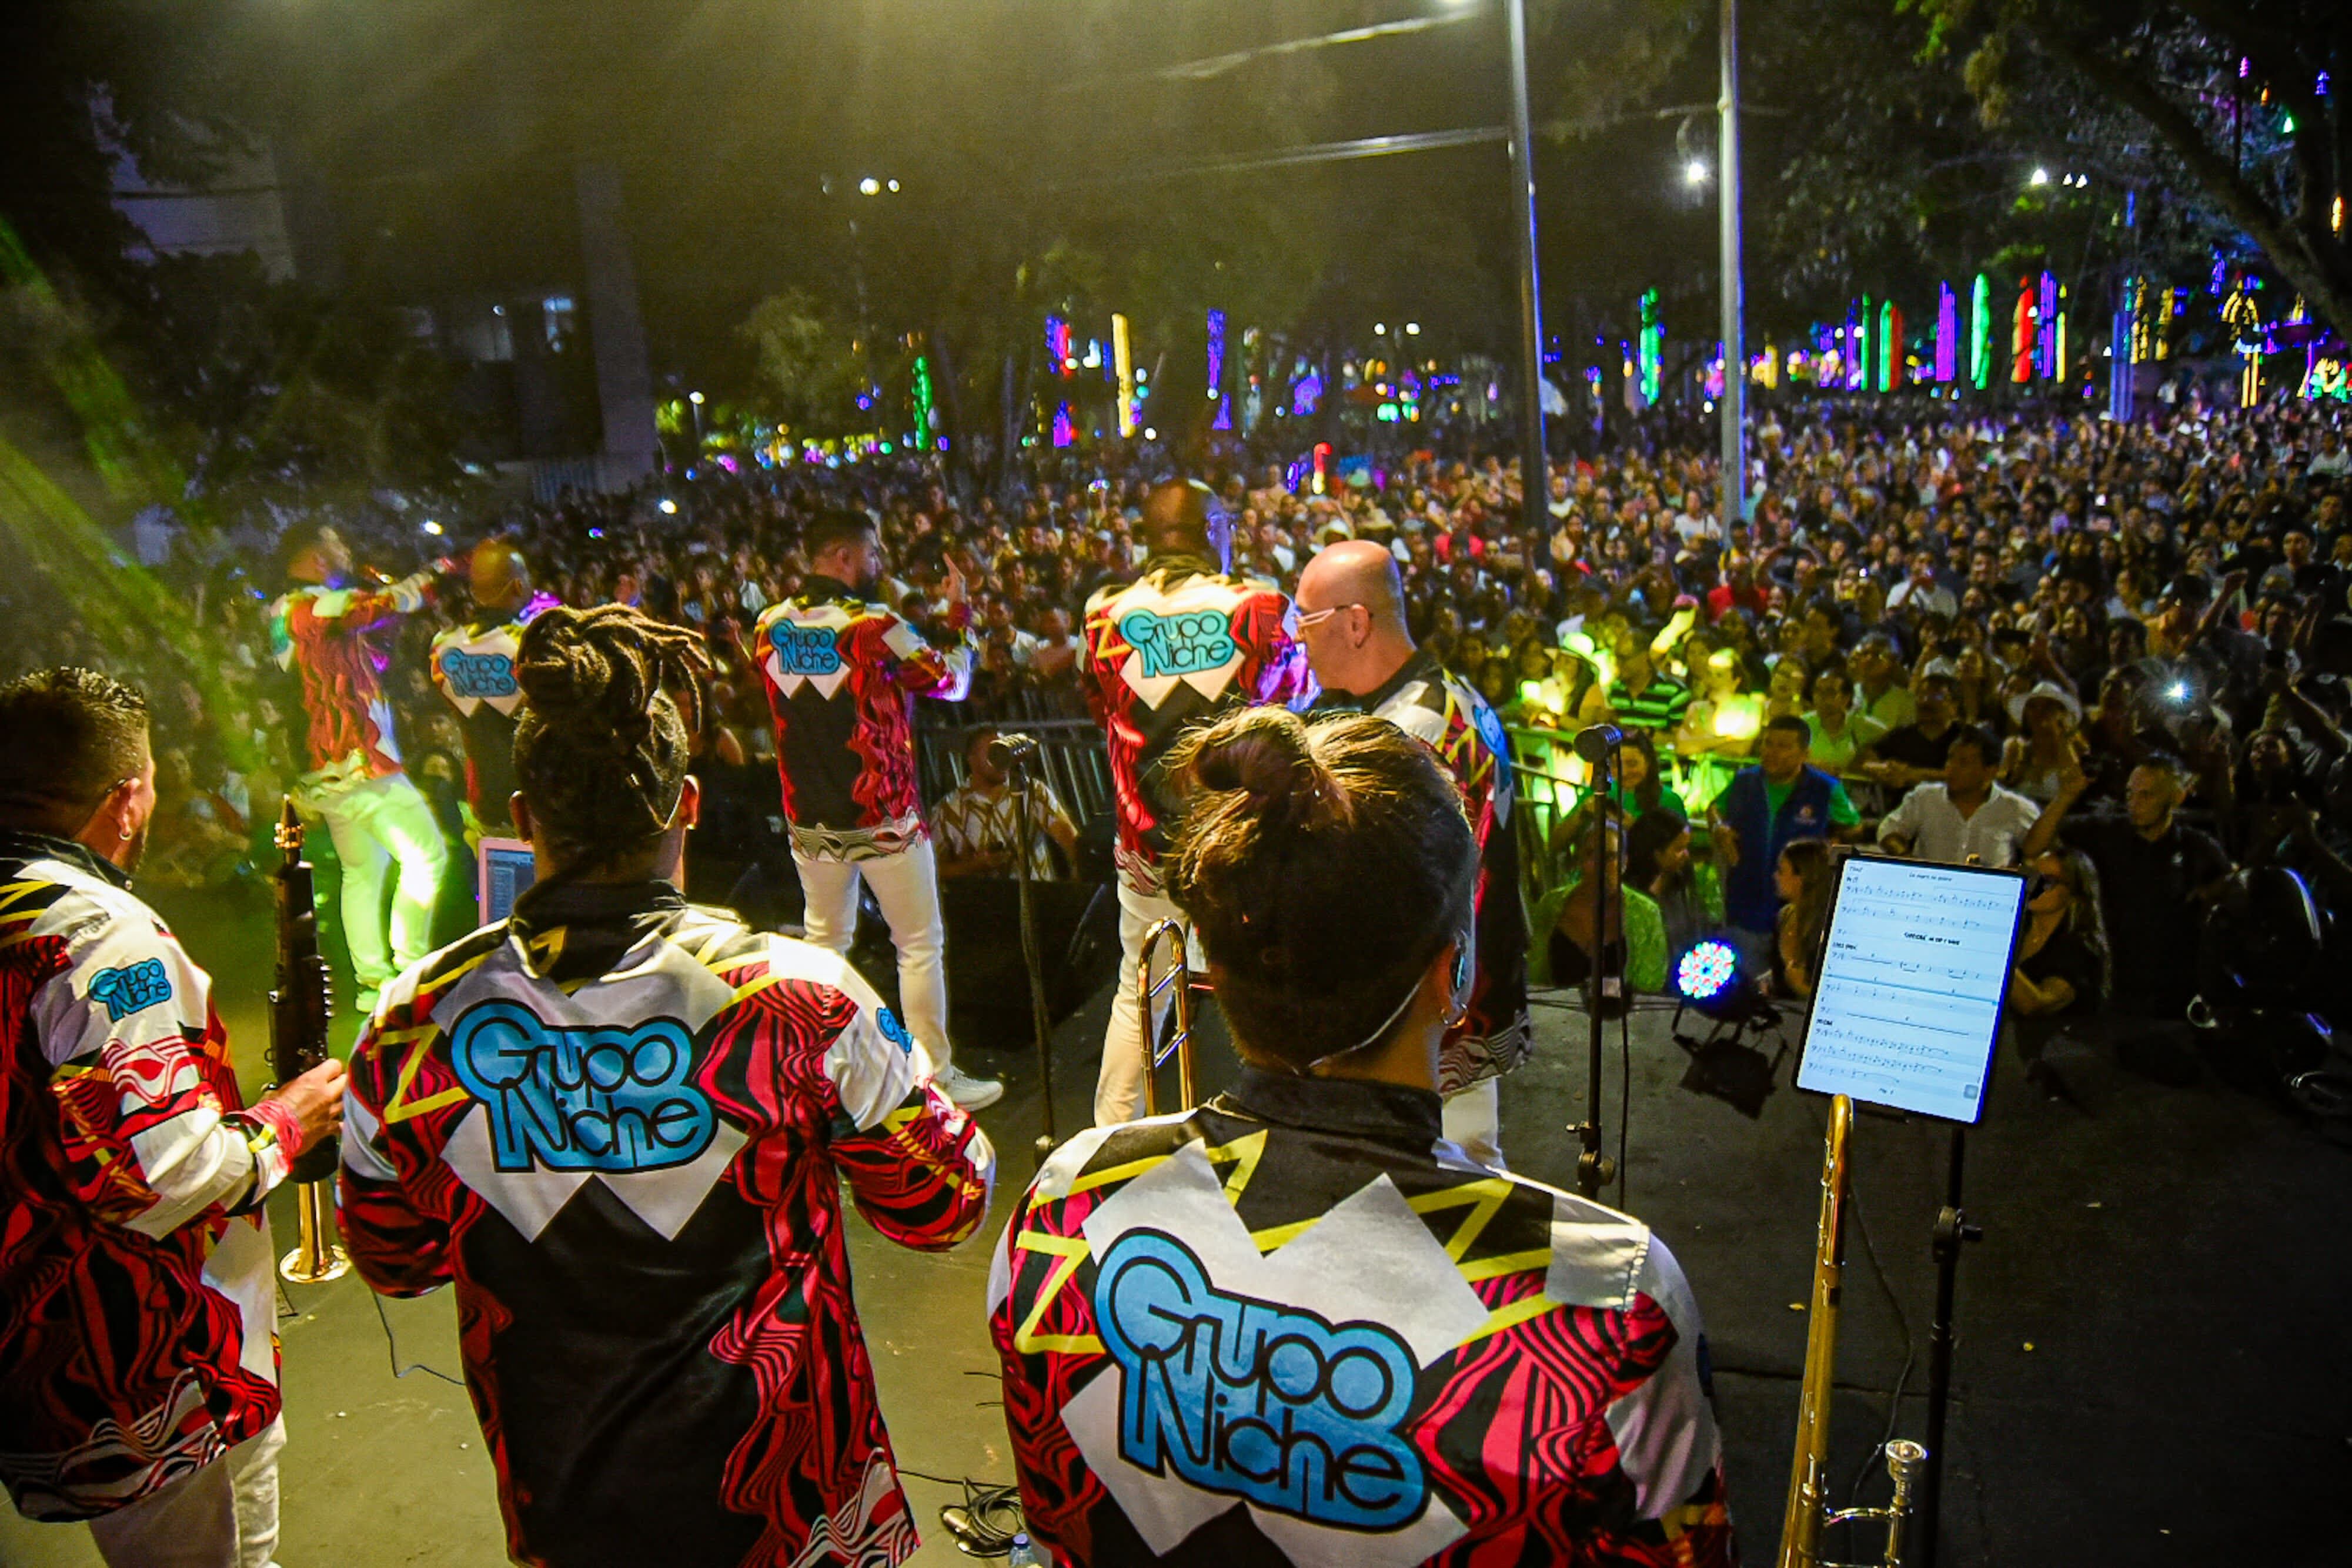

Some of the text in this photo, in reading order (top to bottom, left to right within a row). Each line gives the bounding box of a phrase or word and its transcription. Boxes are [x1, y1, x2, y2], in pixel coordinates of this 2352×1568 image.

[772, 623, 831, 653] Grupo
[1125, 614, 1220, 647] Grupo
[1143, 638, 1228, 670] Niche
[95, 963, 161, 996] Grupo
[469, 1017, 679, 1109] Grupo
[501, 1079, 700, 1156] Niche
[1109, 1256, 1394, 1419] Grupo
[1137, 1343, 1406, 1510] Niche
